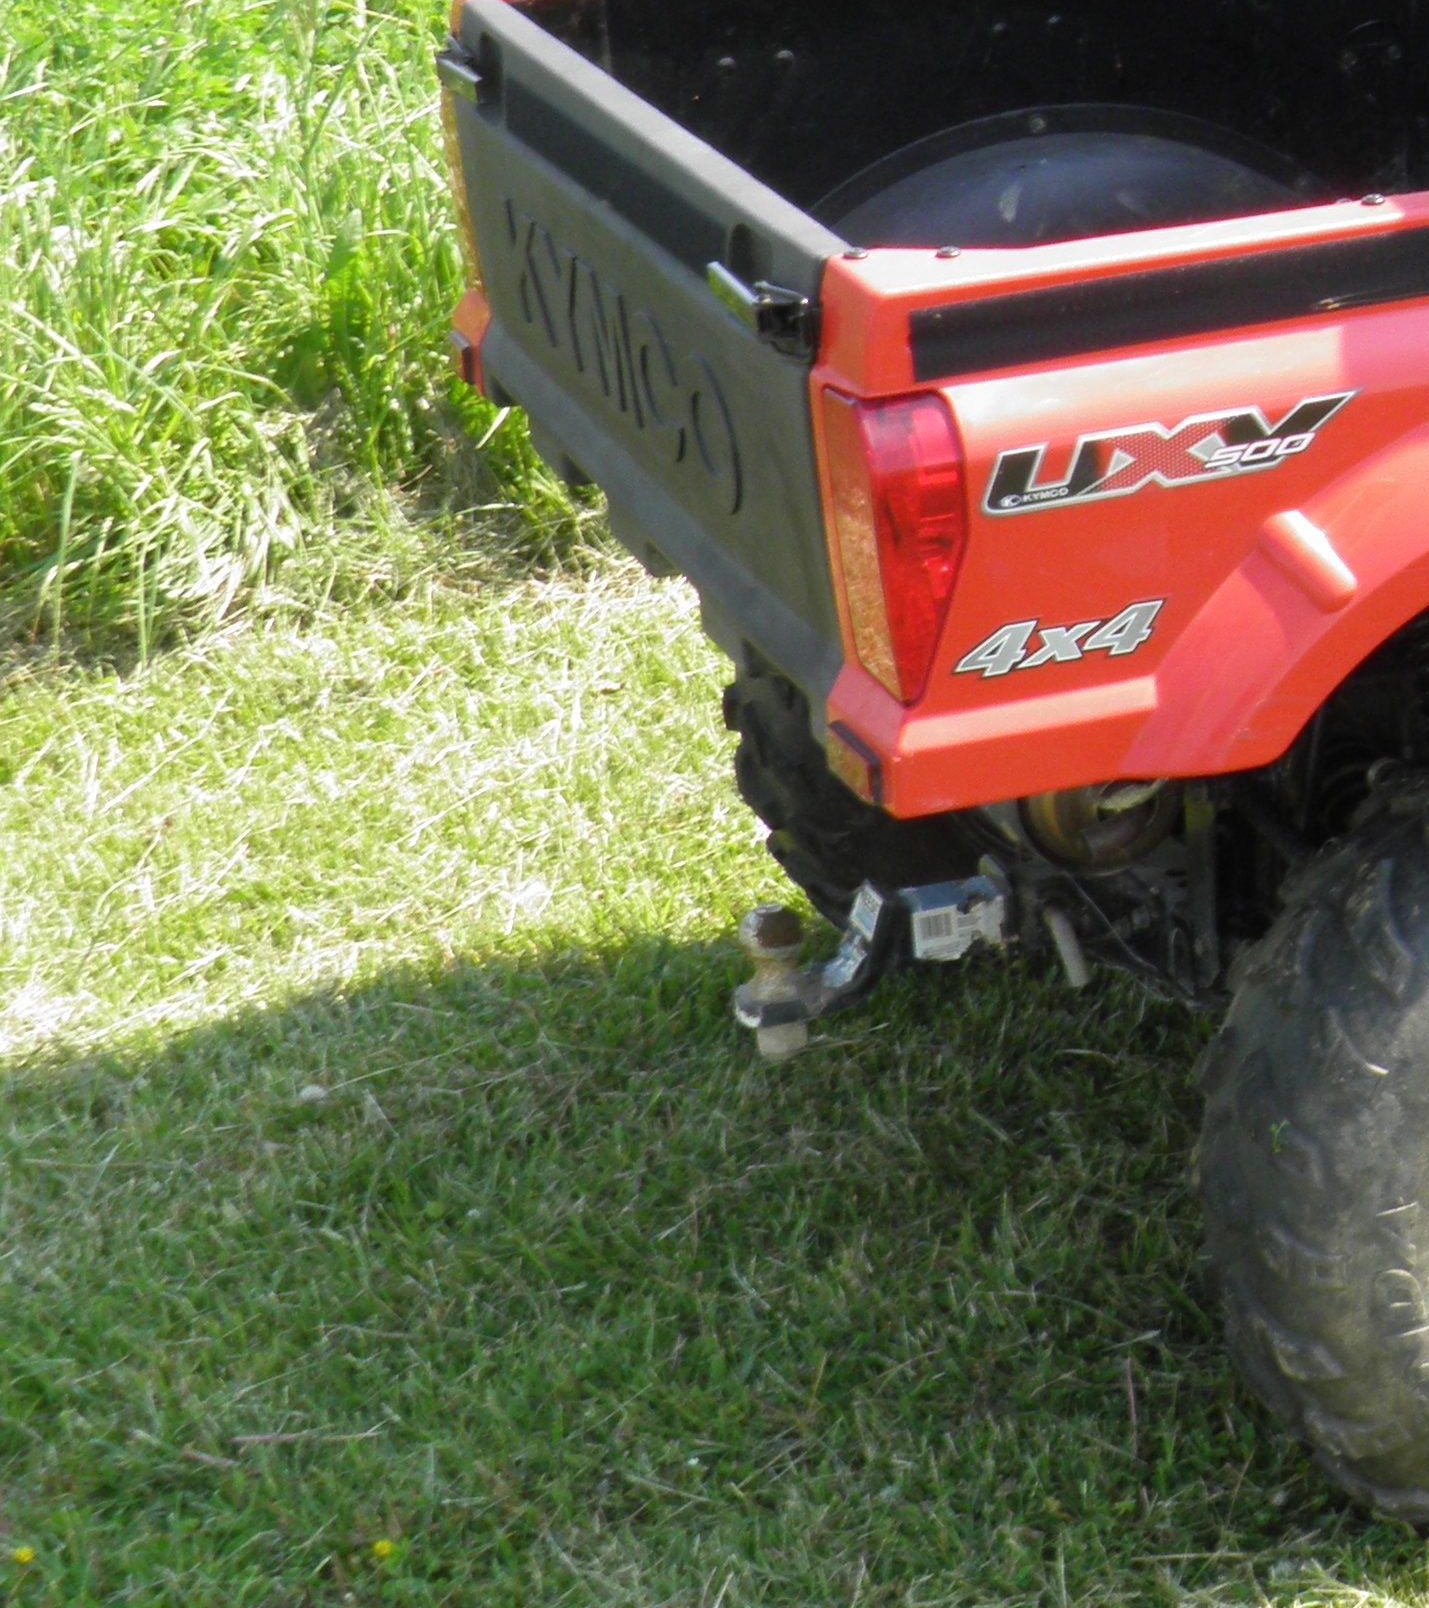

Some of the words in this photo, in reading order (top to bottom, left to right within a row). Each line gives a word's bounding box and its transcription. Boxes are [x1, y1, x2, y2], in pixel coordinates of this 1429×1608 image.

[505, 196, 745, 516] KYMCO
[982, 390, 1357, 515] UXV
[1204, 432, 1316, 469] 500
[1020, 487, 1069, 502] KYMCO
[952, 598, 1168, 679] 4x4
